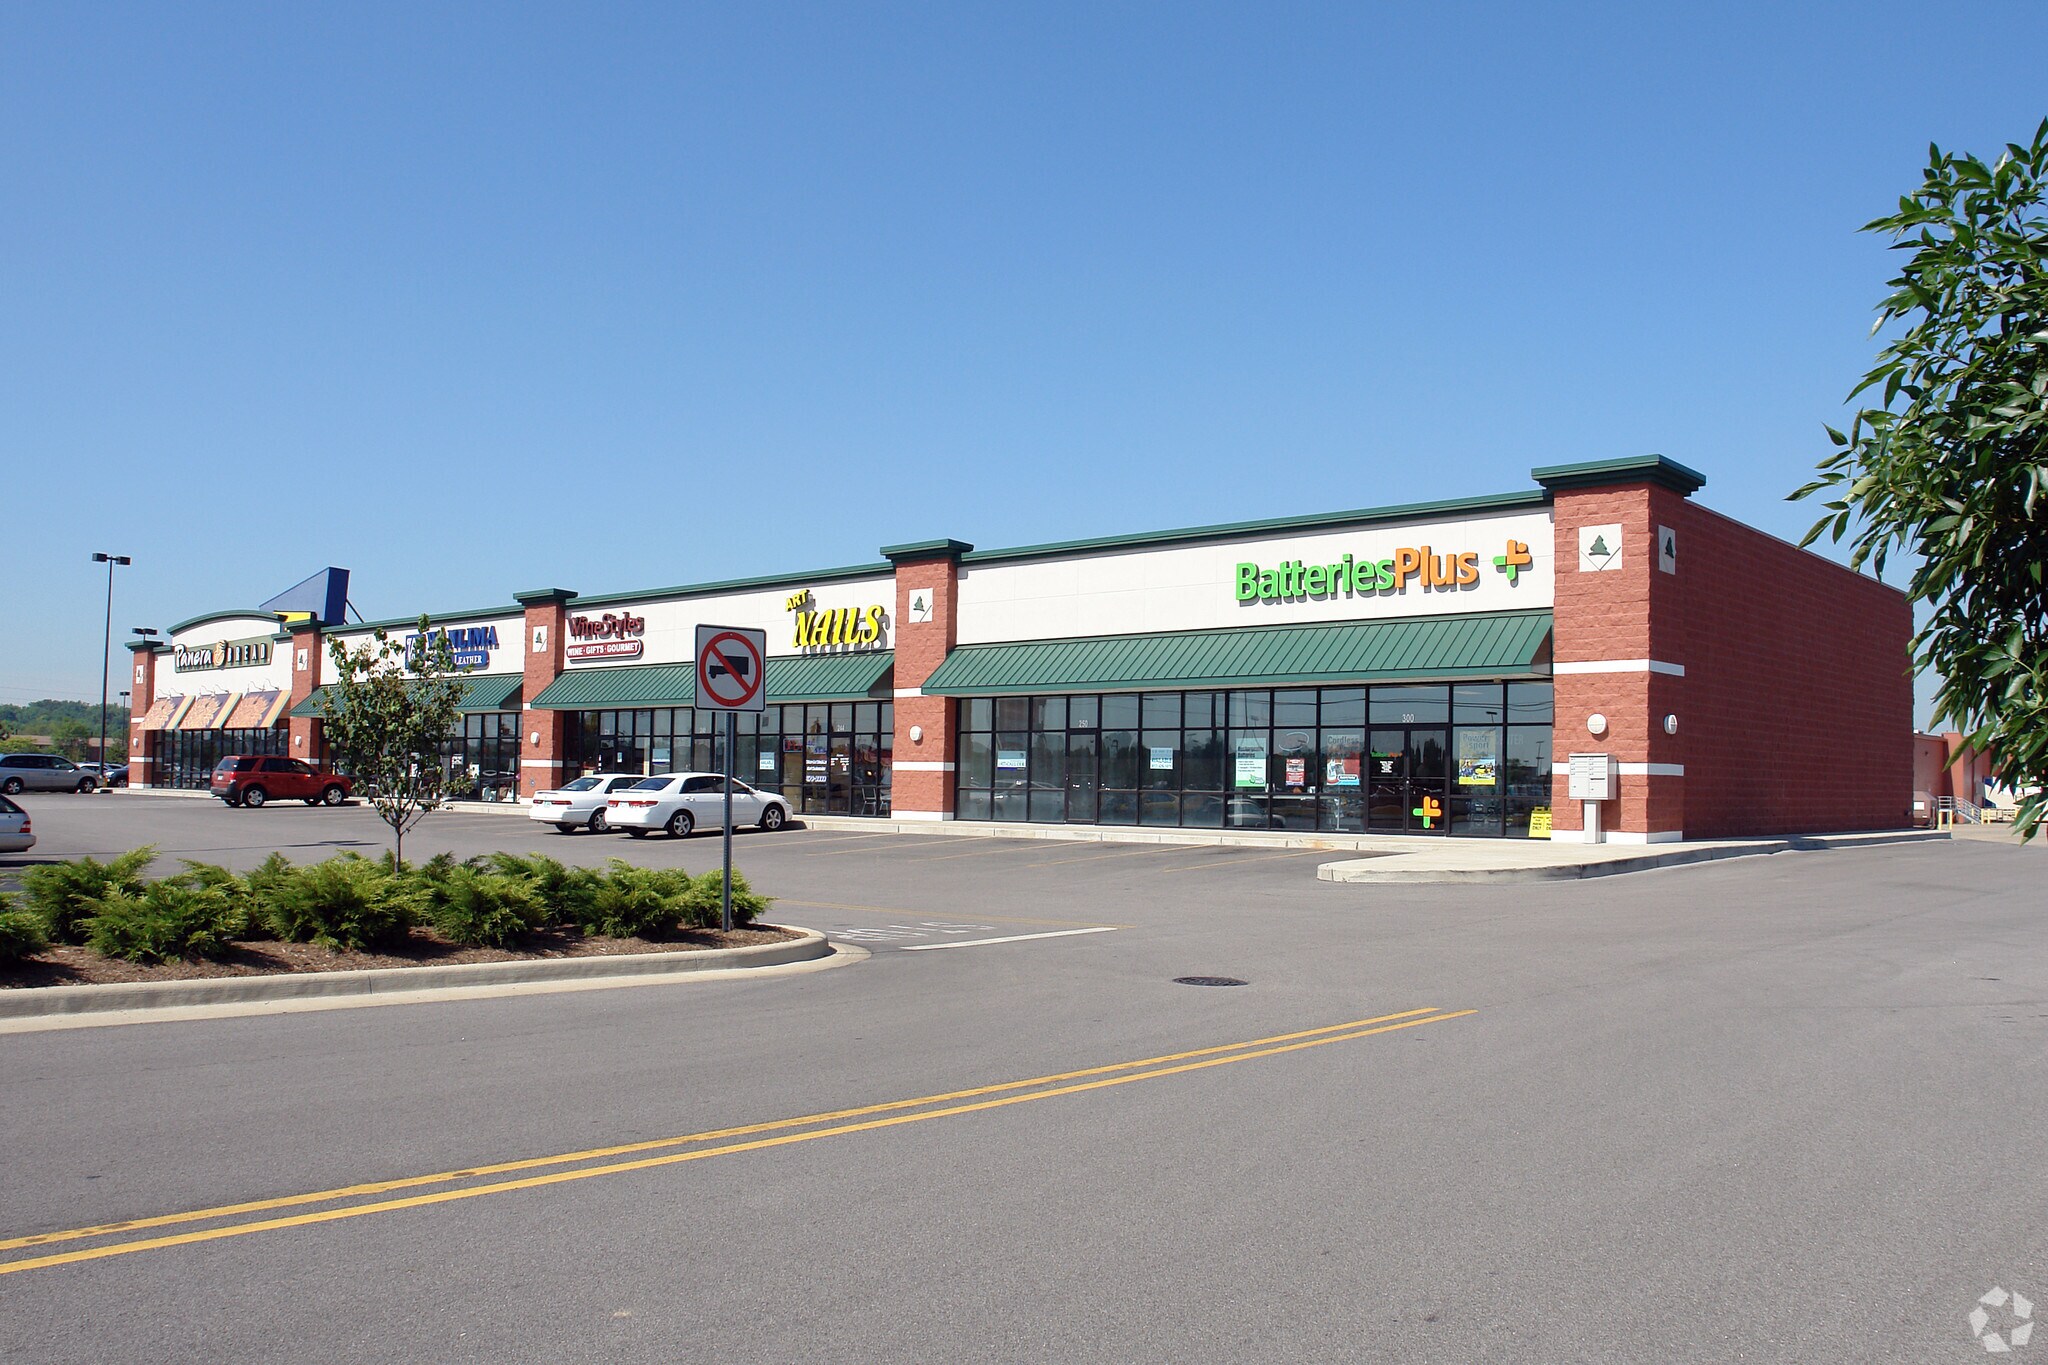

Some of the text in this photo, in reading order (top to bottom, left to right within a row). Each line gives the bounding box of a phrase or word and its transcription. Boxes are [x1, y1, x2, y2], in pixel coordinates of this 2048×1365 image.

[1235, 545, 1479, 601] BatteriesPlus
[785, 589, 810, 612] ART
[567, 611, 645, 640] WineStyles
[792, 604, 885, 648] NAILS
[174, 643, 267, 668] Panera BREAD
[567, 642, 639, 656] WINE GIFTS GOURMET
[1402, 713, 1414, 723] 300
